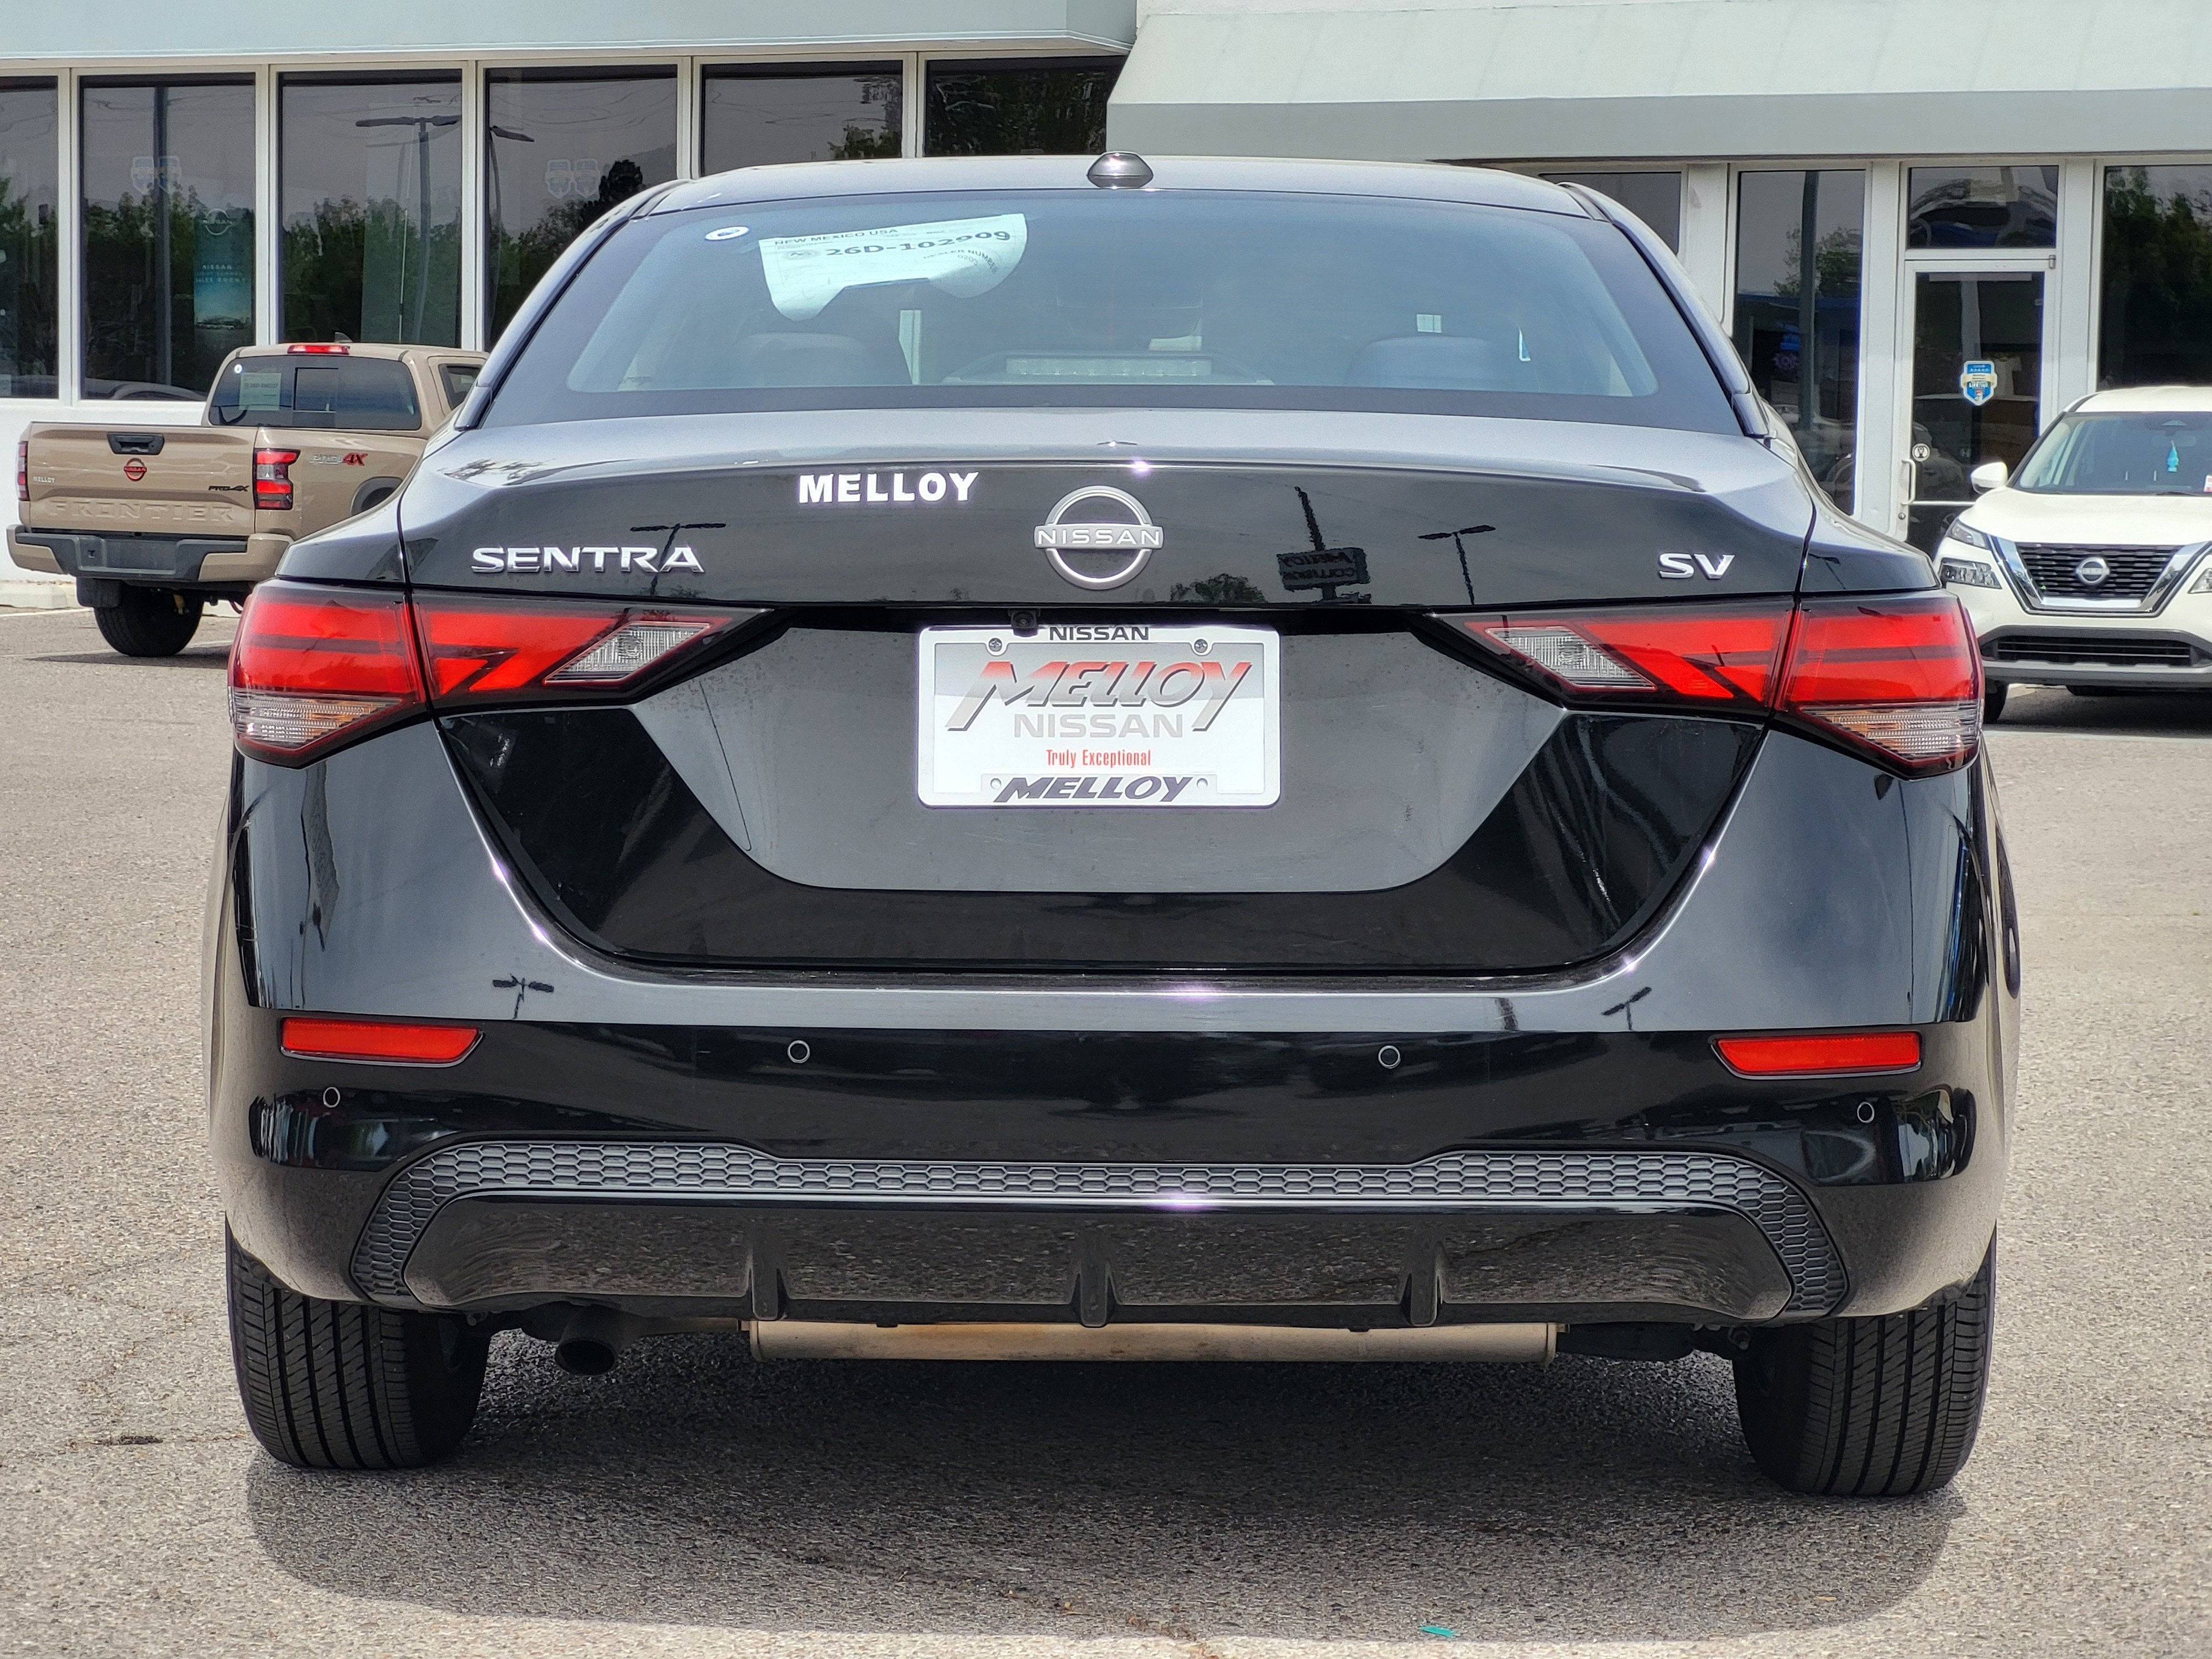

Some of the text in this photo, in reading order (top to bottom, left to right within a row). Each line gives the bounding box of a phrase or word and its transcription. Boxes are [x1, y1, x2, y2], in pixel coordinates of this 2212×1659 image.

[811, 231, 865, 242] MEXICO
[826, 231, 1011, 256] 26D-102909
[799, 472, 979, 503] MELLOY
[49, 500, 234, 521] FRONTIER
[1038, 529, 1160, 546] NISSAN
[471, 546, 705, 572] SENTRA
[1659, 553, 1735, 580] SV
[1050, 626, 1150, 641] NISSAN
[945, 661, 1253, 732] MELLOY
[1014, 714, 1183, 738] NISSAN
[1046, 749, 1151, 768] Truly Exceptional
[993, 775, 1193, 803] MELLOY
